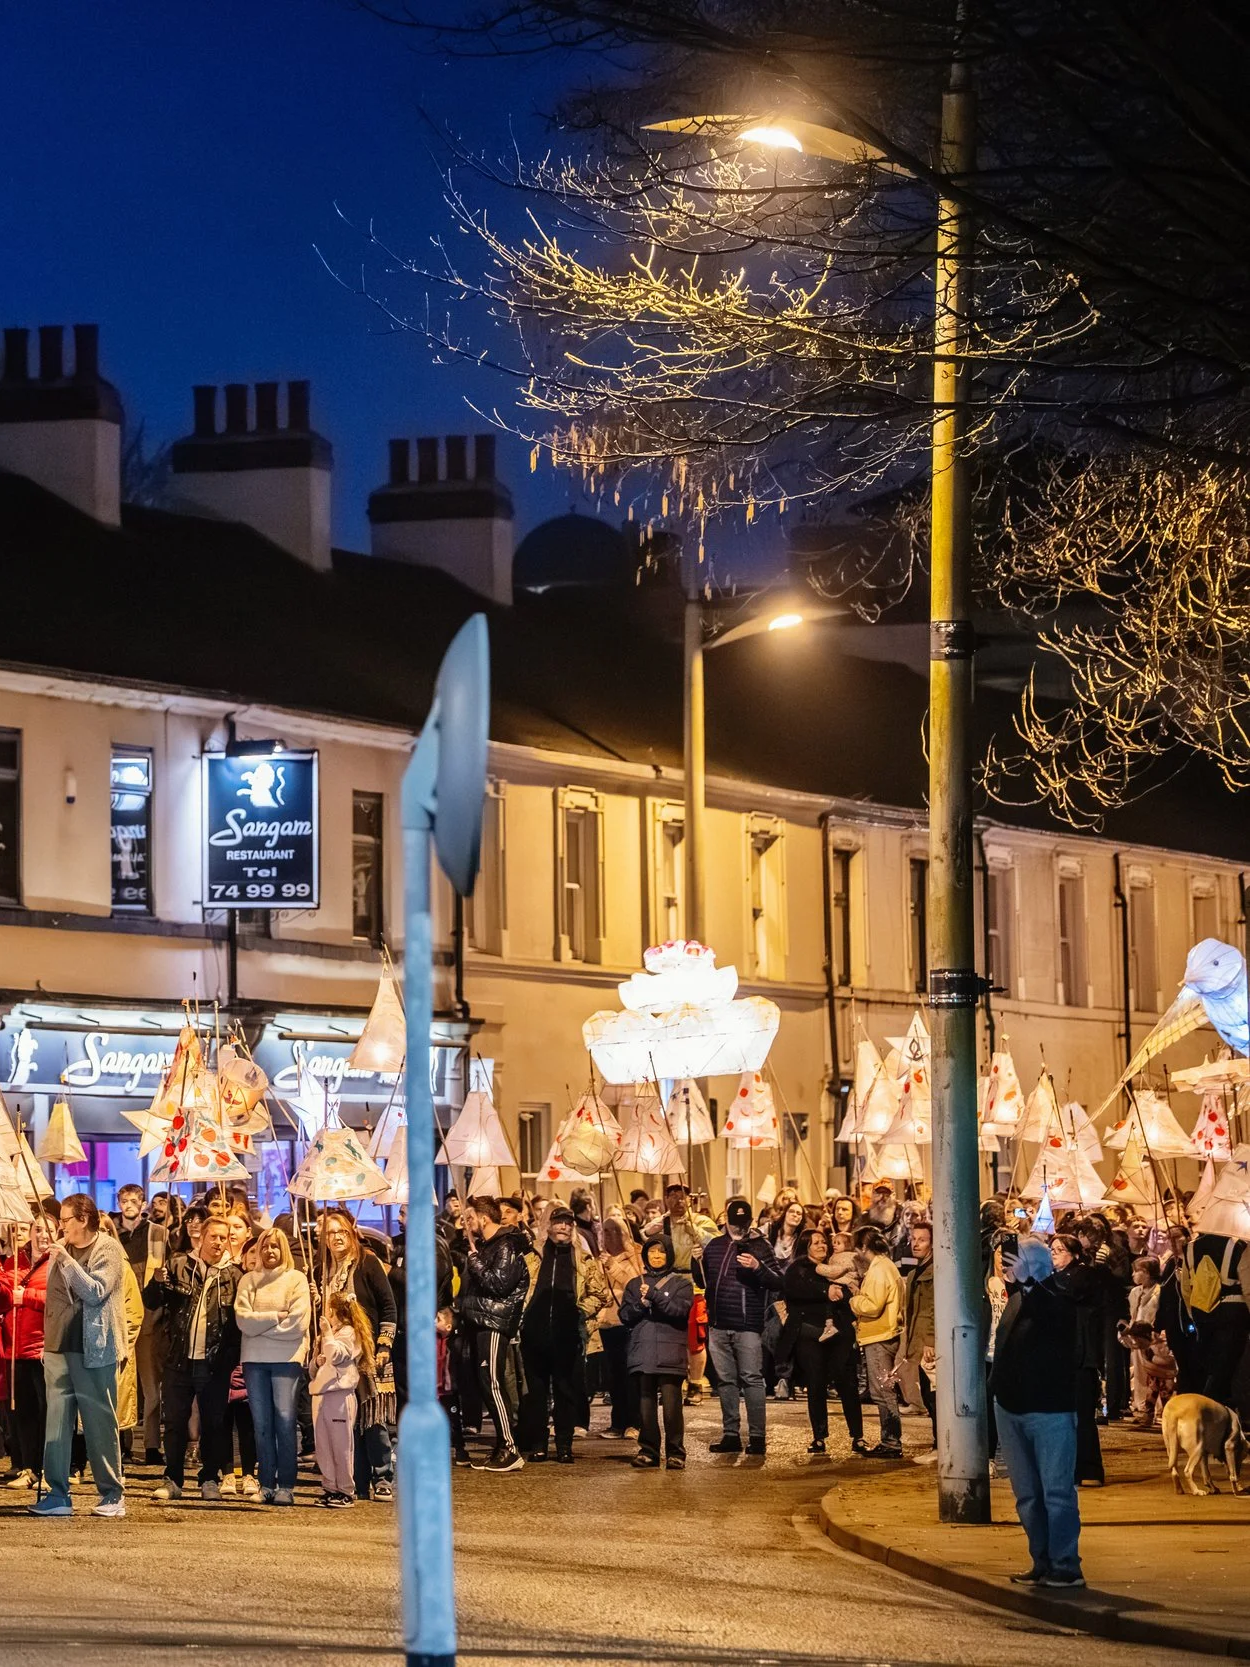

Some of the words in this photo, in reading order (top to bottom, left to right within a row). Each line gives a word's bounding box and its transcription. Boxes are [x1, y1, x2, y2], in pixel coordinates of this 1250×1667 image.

[209, 808, 312, 848] Sangam
[226, 849, 295, 861] RESTAURANT
[242, 866, 278, 878] Tel
[210, 884, 240, 899] 74
[246, 884, 276, 899] 99
[281, 883, 311, 898] 99
